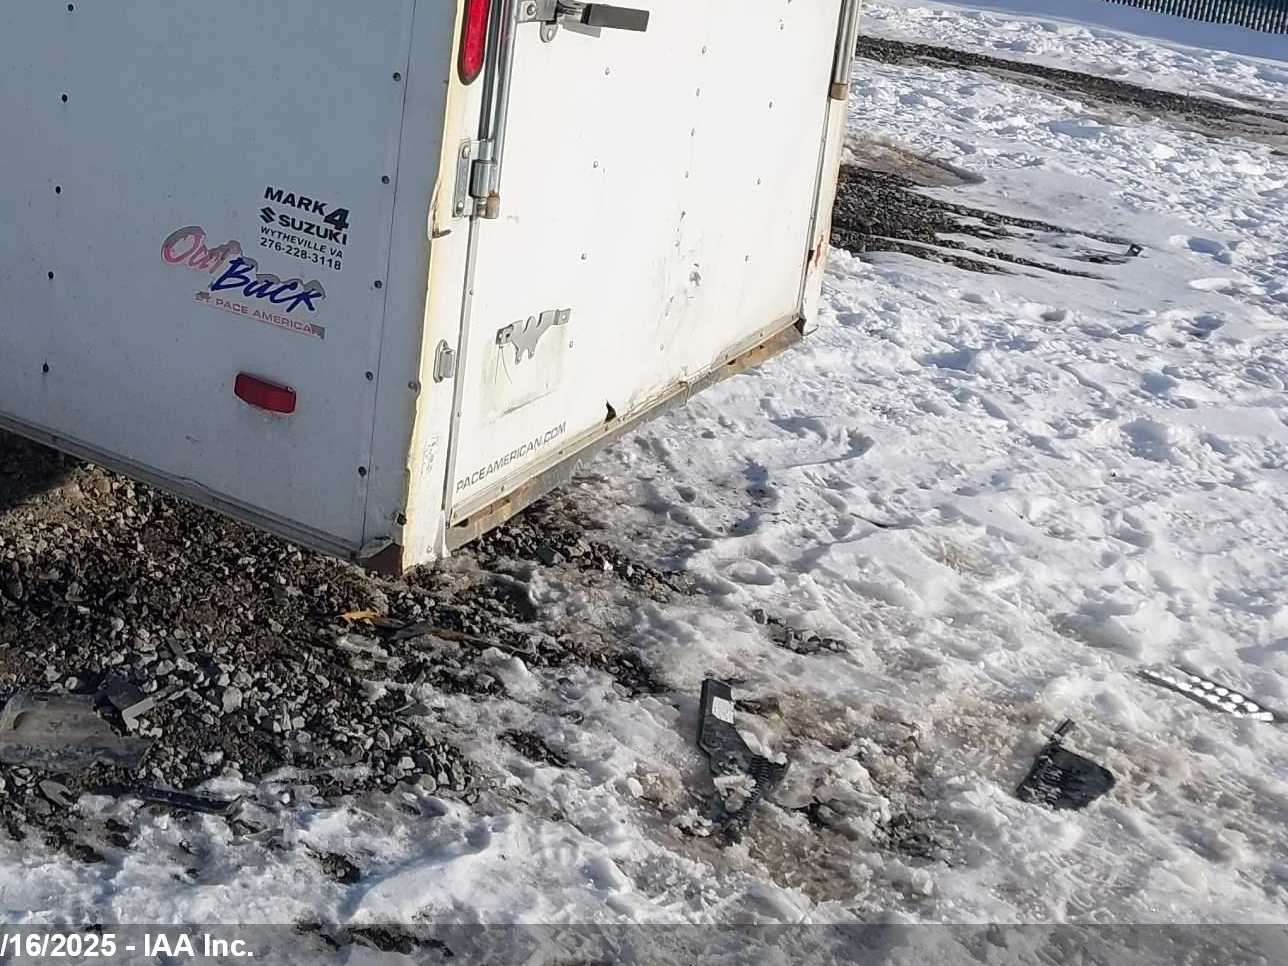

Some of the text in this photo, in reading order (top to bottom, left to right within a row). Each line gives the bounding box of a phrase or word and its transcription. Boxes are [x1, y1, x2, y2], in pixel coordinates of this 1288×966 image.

[261, 226, 343, 259] WYTHEVILLE VA
[278, 214, 347, 245] SUZUKI
[260, 237, 341, 270] 276-228-3118
[210, 256, 324, 313] Back
[215, 298, 249, 314] PACE
[456, 421, 566, 493] PACEAMERICAN.COM
